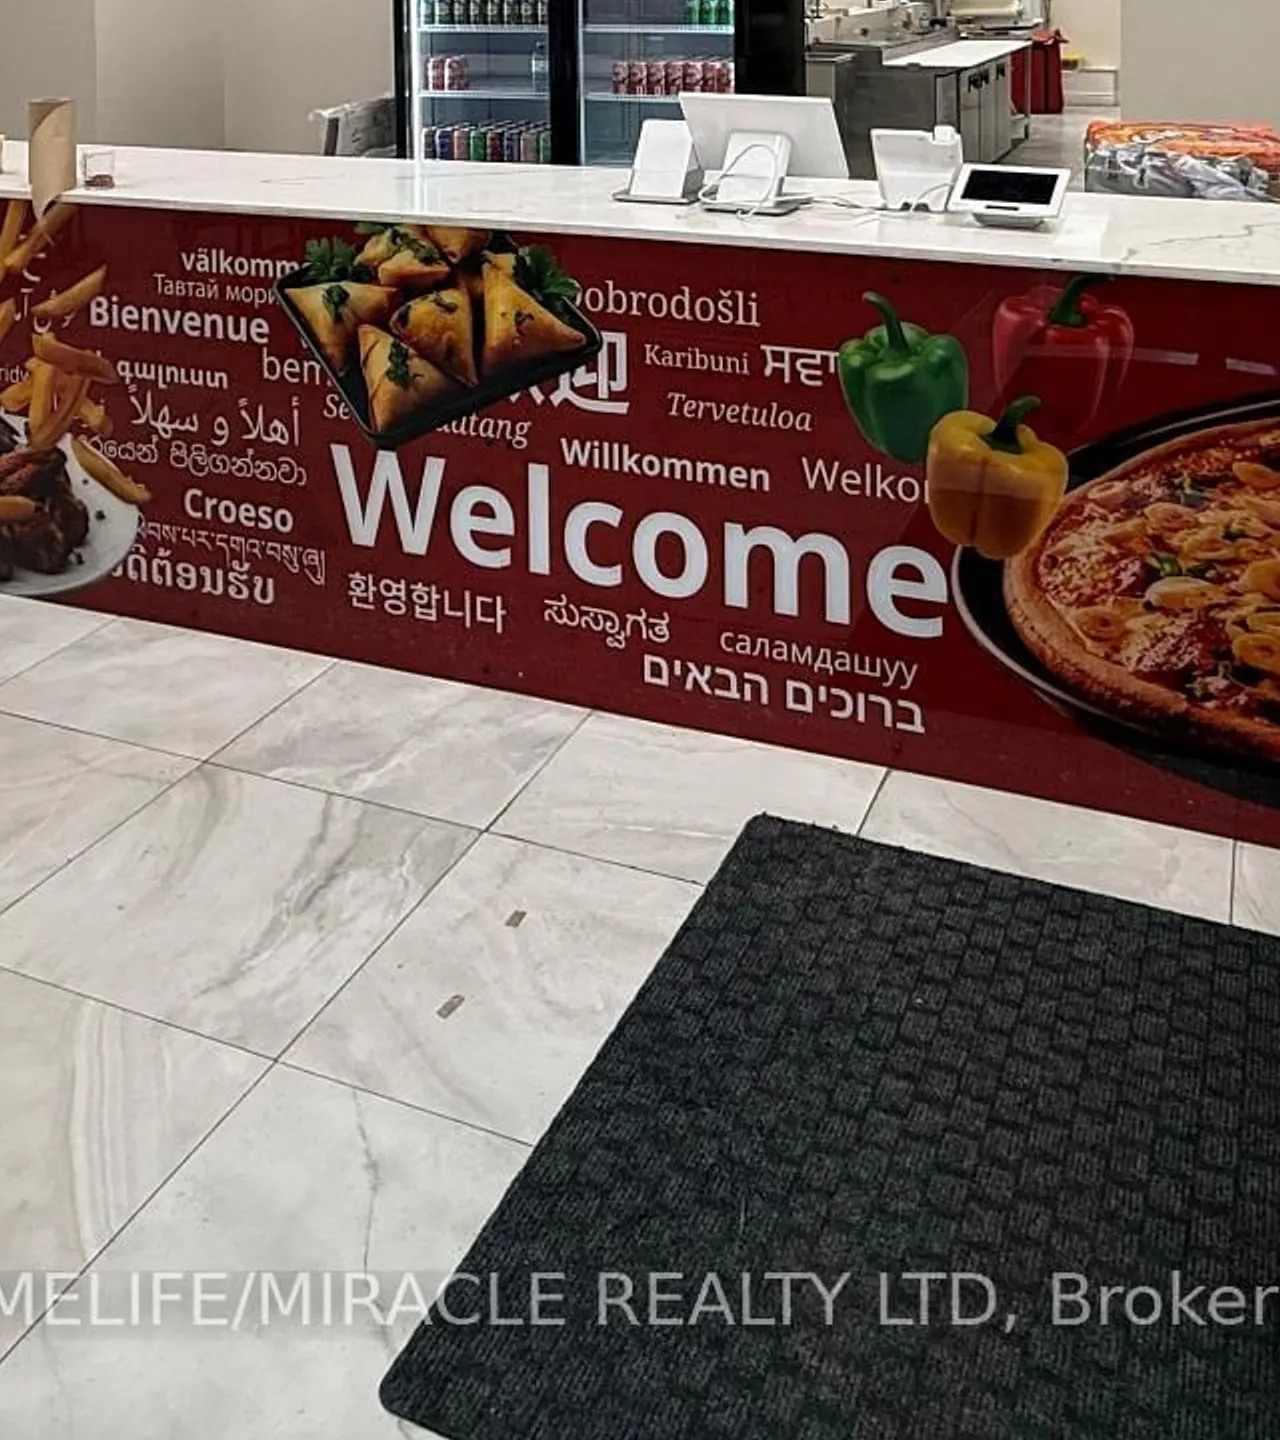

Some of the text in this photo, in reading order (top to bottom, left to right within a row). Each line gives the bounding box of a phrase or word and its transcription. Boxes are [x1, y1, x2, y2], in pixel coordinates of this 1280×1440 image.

[153, 273, 219, 299] Тавтай
[90, 296, 269, 344] Bienvenue
[643, 344, 750, 375] Karibuni
[665, 391, 813, 433] Tervetuloa
[561, 437, 770, 492] Willkommen
[802, 457, 929, 504] Welko
[183, 488, 294, 533] Croeso
[331, 444, 949, 639] Welcome
[347, 570, 508, 634] 환영합니다
[719, 631, 918, 690] саламдашуу
[643, 653, 925, 734] ברוכים הבאים
